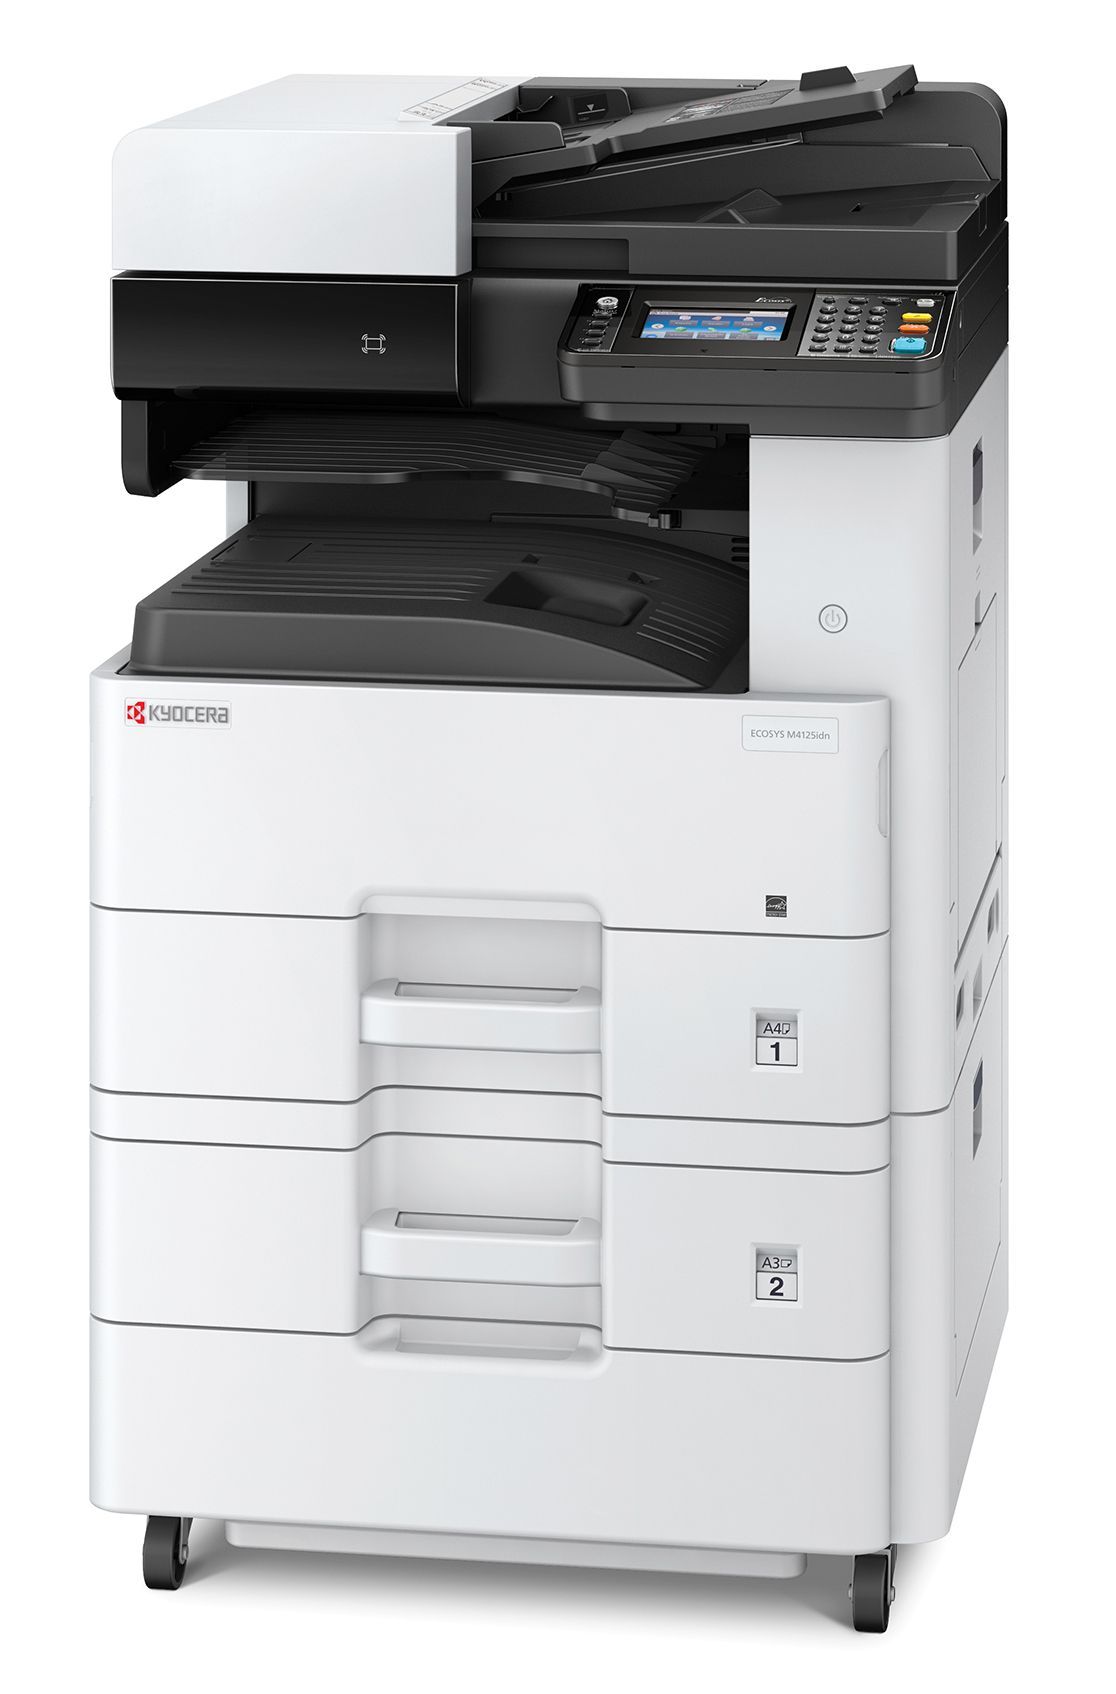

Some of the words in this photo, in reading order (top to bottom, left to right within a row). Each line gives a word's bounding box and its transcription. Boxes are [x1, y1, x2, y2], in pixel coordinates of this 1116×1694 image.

[149, 705, 229, 723] KYOCERA
[751, 729, 785, 739] ECOSYS
[787, 730, 830, 740] M4125idn
[763, 1022, 781, 1034] A4
[770, 1041, 780, 1061] 1
[762, 1256, 780, 1269] A3
[769, 1276, 784, 1296] 2
